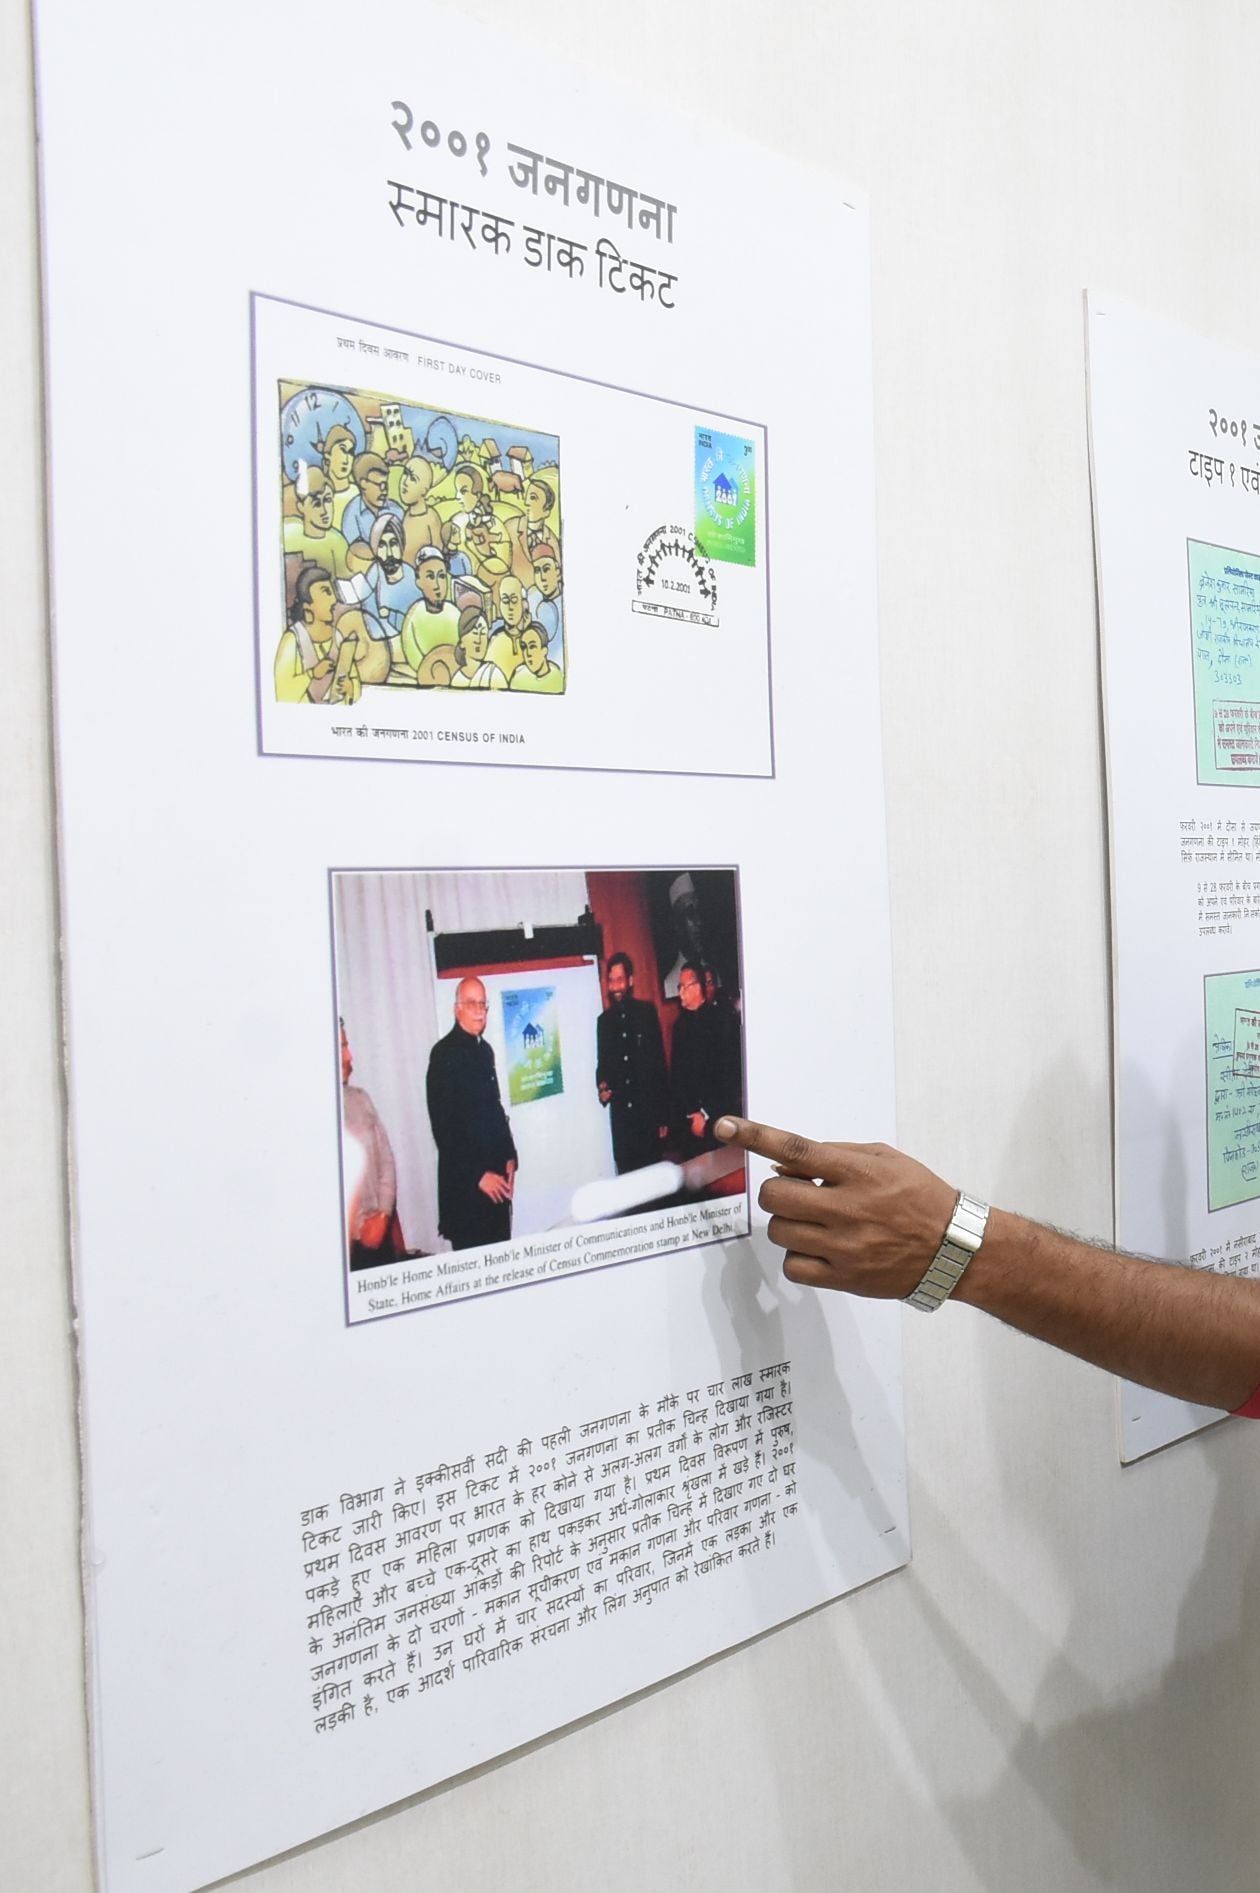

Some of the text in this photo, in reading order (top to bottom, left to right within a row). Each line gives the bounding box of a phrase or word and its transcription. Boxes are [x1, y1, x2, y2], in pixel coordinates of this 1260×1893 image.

[391, 100, 677, 244] २००१ जनगणना
[386, 179, 678, 309] स्मारक डाक टिकट
[336, 336, 501, 384] प्रथम दिवस आवरण FIRST DAY COVER
[1208, 408, 1247, 447] २००१
[1188, 449, 1225, 488] टाइप
[1229, 462, 1235, 487] १
[1239, 462, 1260, 495] एवं
[669, 525, 686, 537] 2001
[330, 724, 525, 744] भारत की जनगणना 2001 CENSUS OF INDIA
[357, 1274, 398, 1294] Honb'le
[402, 1269, 433, 1285] Home
[483, 1249, 520, 1267] Honb'le
[523, 1242, 562, 1258] Minister
[563, 1236, 573, 1249] of
[575, 1224, 647, 1247] Communications
[649, 1218, 665, 1232] and
[666, 1212, 697, 1229] Honb'le
[699, 1207, 732, 1223] Minister
[733, 1201, 742, 1214] of
[401, 1289, 432, 1305] Home
[435, 1281, 470, 1297] Affairs
[473, 1277, 482, 1289] at
[484, 1274, 500, 1286] the
[502, 1267, 535, 1283] release
[536, 1260, 548, 1274] of
[548, 1257, 582, 1272] Census
[583, 1241, 654, 1264] Commemoration
[656, 1235, 680, 1248] stamp
[682, 1233, 689, 1242] at
[691, 1228, 709, 1240] New
[299, 1503, 330, 1527] डाक
[339, 1486, 385, 1514] विभाग
[393, 1476, 406, 1496] ने
[483, 1444, 509, 1469] सदी
[516, 1437, 533, 1457] की
[540, 1425, 572, 1451] पहली
[578, 1410, 632, 1438] जनगणना
[638, 1402, 650, 1419] के
[656, 1393, 680, 1413] मौके
[685, 1388, 700, 1404] पर
[706, 1381, 725, 1397] चार
[730, 1372, 753, 1390] लाख
[758, 1360, 791, 1382] स्मारक
[301, 1525, 343, 1553] टिकट
[351, 1509, 383, 1535] जारी
[435, 1489, 457, 1512] इस
[464, 1475, 500, 1499] टिकट
[507, 1464, 520, 1484] में
[528, 1456, 556, 1478] २००१
[564, 1436, 619, 1466] जनगणना
[625, 1430, 640, 1446] का
[646, 1418, 676, 1439] प्रतीक
[714, 1394, 750, 1417] दिखाया
[755, 1386, 775, 1403] गया
[303, 1552, 340, 1578] प्रथम
[347, 1537, 387, 1564] दिवस
[394, 1518, 442, 1549] आवरण
[448, 1510, 467, 1528] पर
[473, 1497, 506, 1520] भारत
[512, 1488, 525, 1507] के
[530, 1483, 547, 1504] हर
[552, 1470, 578, 1493] कोने
[583, 1464, 595, 1484] से
[600, 1445, 662, 1478] अलग-अलग
[692, 1429, 703, 1445] के
[707, 1422, 729, 1441] लोग
[734, 1413, 752, 1432] और
[756, 1401, 793, 1424] रजिस्टर
[351, 1568, 372, 1596] हुए
[381, 1556, 406, 1577] एक
[415, 1538, 458, 1565] महिला
[466, 1519, 511, 1547] प्रगणक
[519, 1508, 536, 1528] को
[543, 1494, 586, 1521] दिखाया
[593, 1483, 616, 1501] गया
[644, 1464, 671, 1485] प्रथम
[678, 1451, 706, 1473] दिवस
[754, 1429, 764, 1445] में
[372, 1583, 398, 1608] और
[405, 1567, 437, 1593] बच्चे
[505, 1540, 522, 1557] का
[528, 1529, 551, 1553] हाथ
